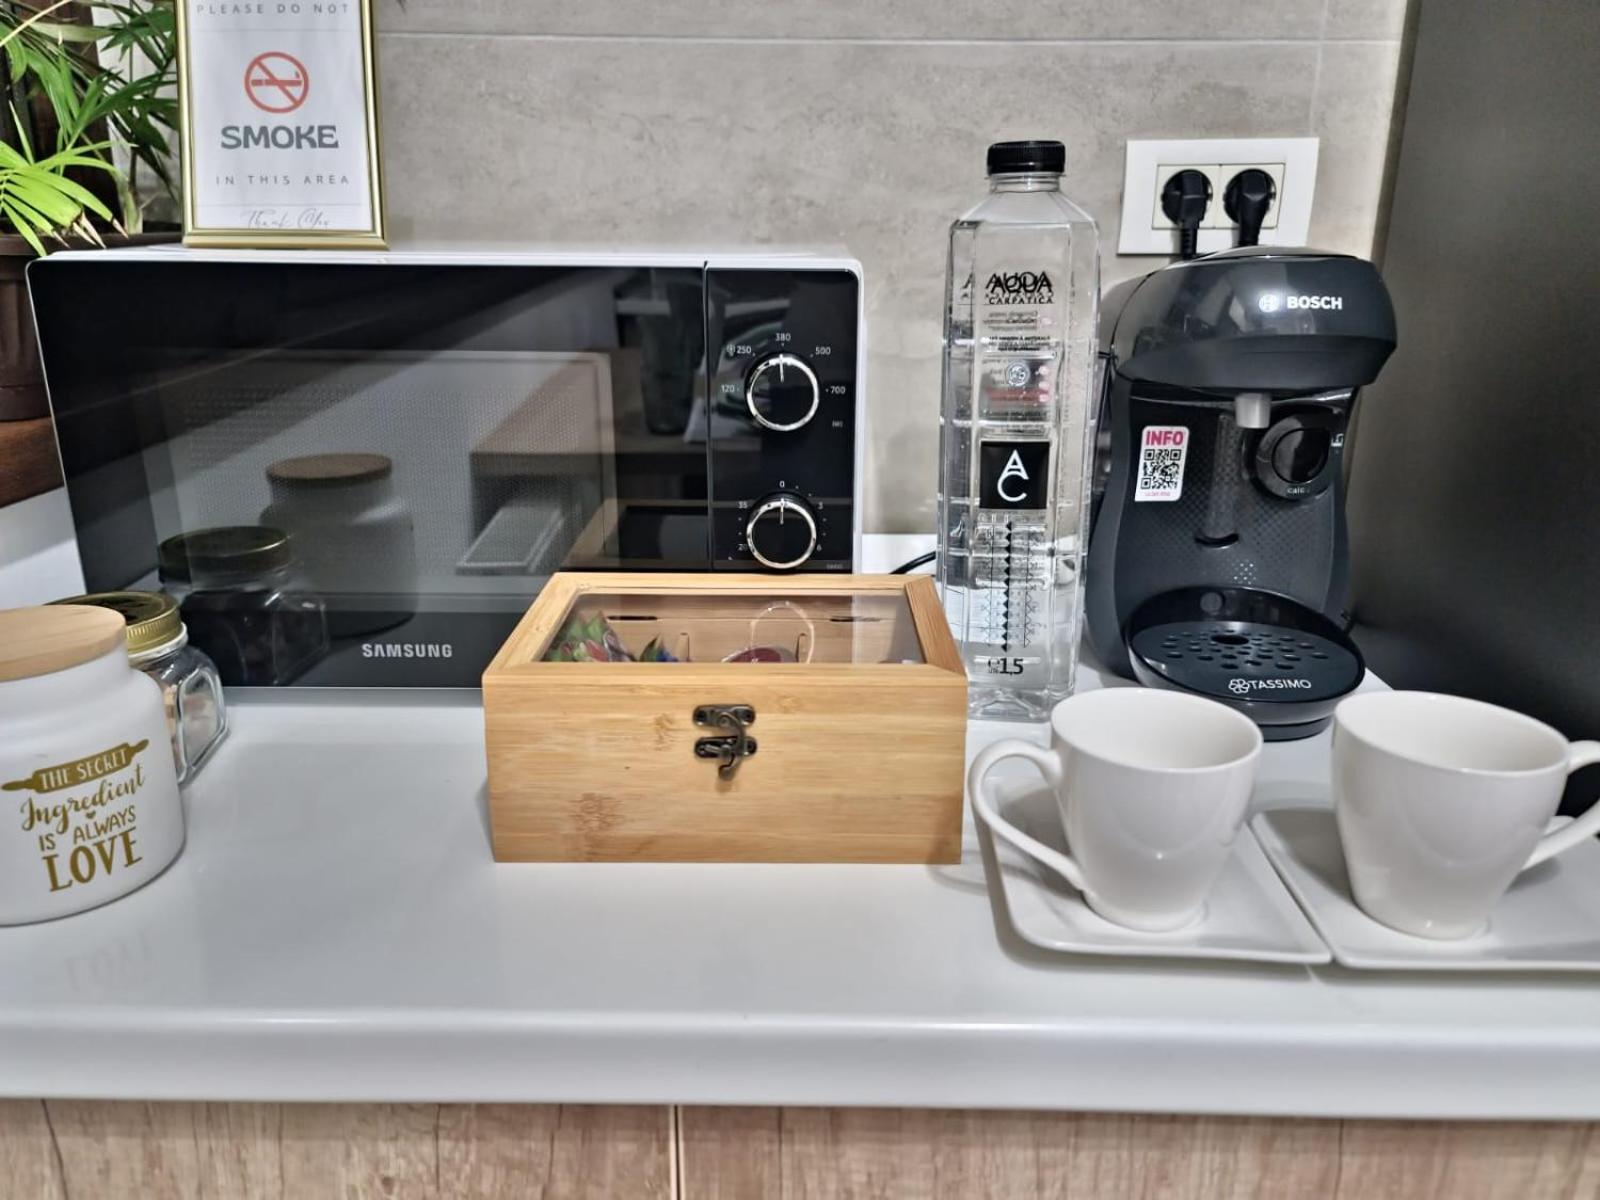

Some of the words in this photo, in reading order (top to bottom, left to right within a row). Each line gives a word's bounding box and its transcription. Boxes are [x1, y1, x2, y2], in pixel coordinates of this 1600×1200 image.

[197, 4, 265, 14] PLEASE
[276, 4, 301, 14] DO
[313, 3, 349, 14] NOT
[221, 125, 339, 149] SMOKE
[216, 175, 235, 185] IN
[248, 175, 290, 185] THIS
[303, 175, 350, 185] AREA
[988, 297, 1053, 305] CARPATICA
[1287, 296, 1343, 310] BOSCH
[775, 333, 791, 342] 380
[736, 345, 752, 354] 250
[815, 346, 831, 355] 500
[721, 385, 735, 393] 120
[830, 386, 846, 395] 700
[1146, 430, 1184, 446] INFO
[779, 480, 786, 489] 0
[362, 643, 453, 658] SAMSUNG
[1249, 679, 1312, 689] TASSIMO
[40, 767, 71, 791] THE
[76, 747, 127, 780] SECRET
[20, 763, 146, 835] Ingredient
[38, 832, 56, 852] IS
[73, 805, 137, 845] ALWAYS
[42, 826, 143, 892] LOVE
